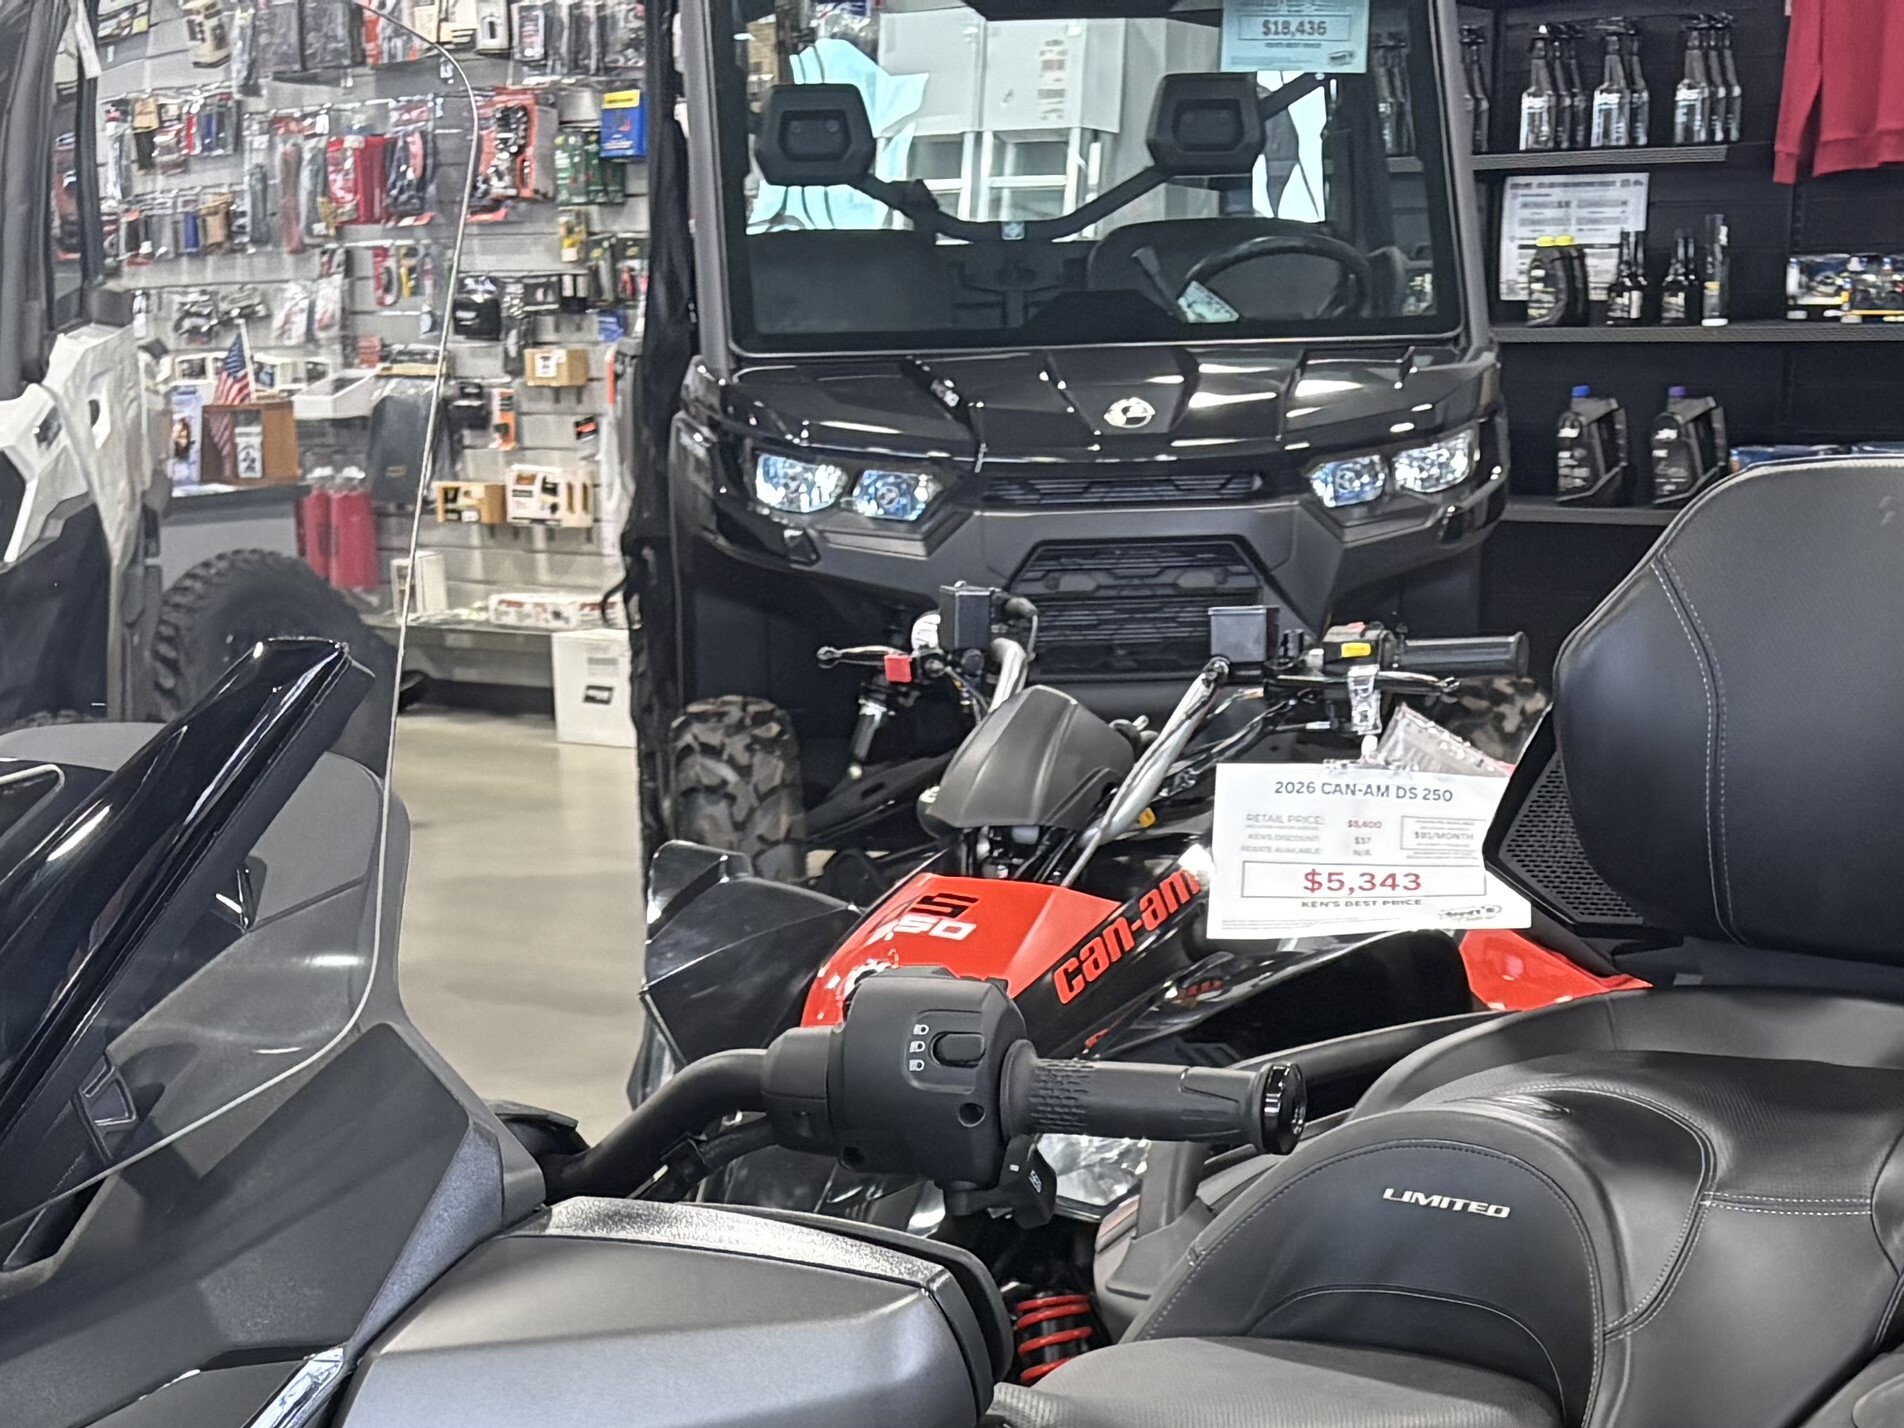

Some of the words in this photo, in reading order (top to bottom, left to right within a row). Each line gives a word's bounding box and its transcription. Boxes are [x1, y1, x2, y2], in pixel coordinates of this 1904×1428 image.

[1263, 19, 1327, 37] $18,436
[1275, 781, 1316, 795] 2026
[1321, 782, 1391, 798] CAN-AM
[1396, 785, 1419, 799] DS
[1422, 788, 1454, 803] 250
[1304, 868, 1422, 896] $5,343
[1382, 899, 1422, 907] PRICE
[1053, 869, 1201, 1005] can-am
[1383, 1188, 1511, 1218] LIMITED
